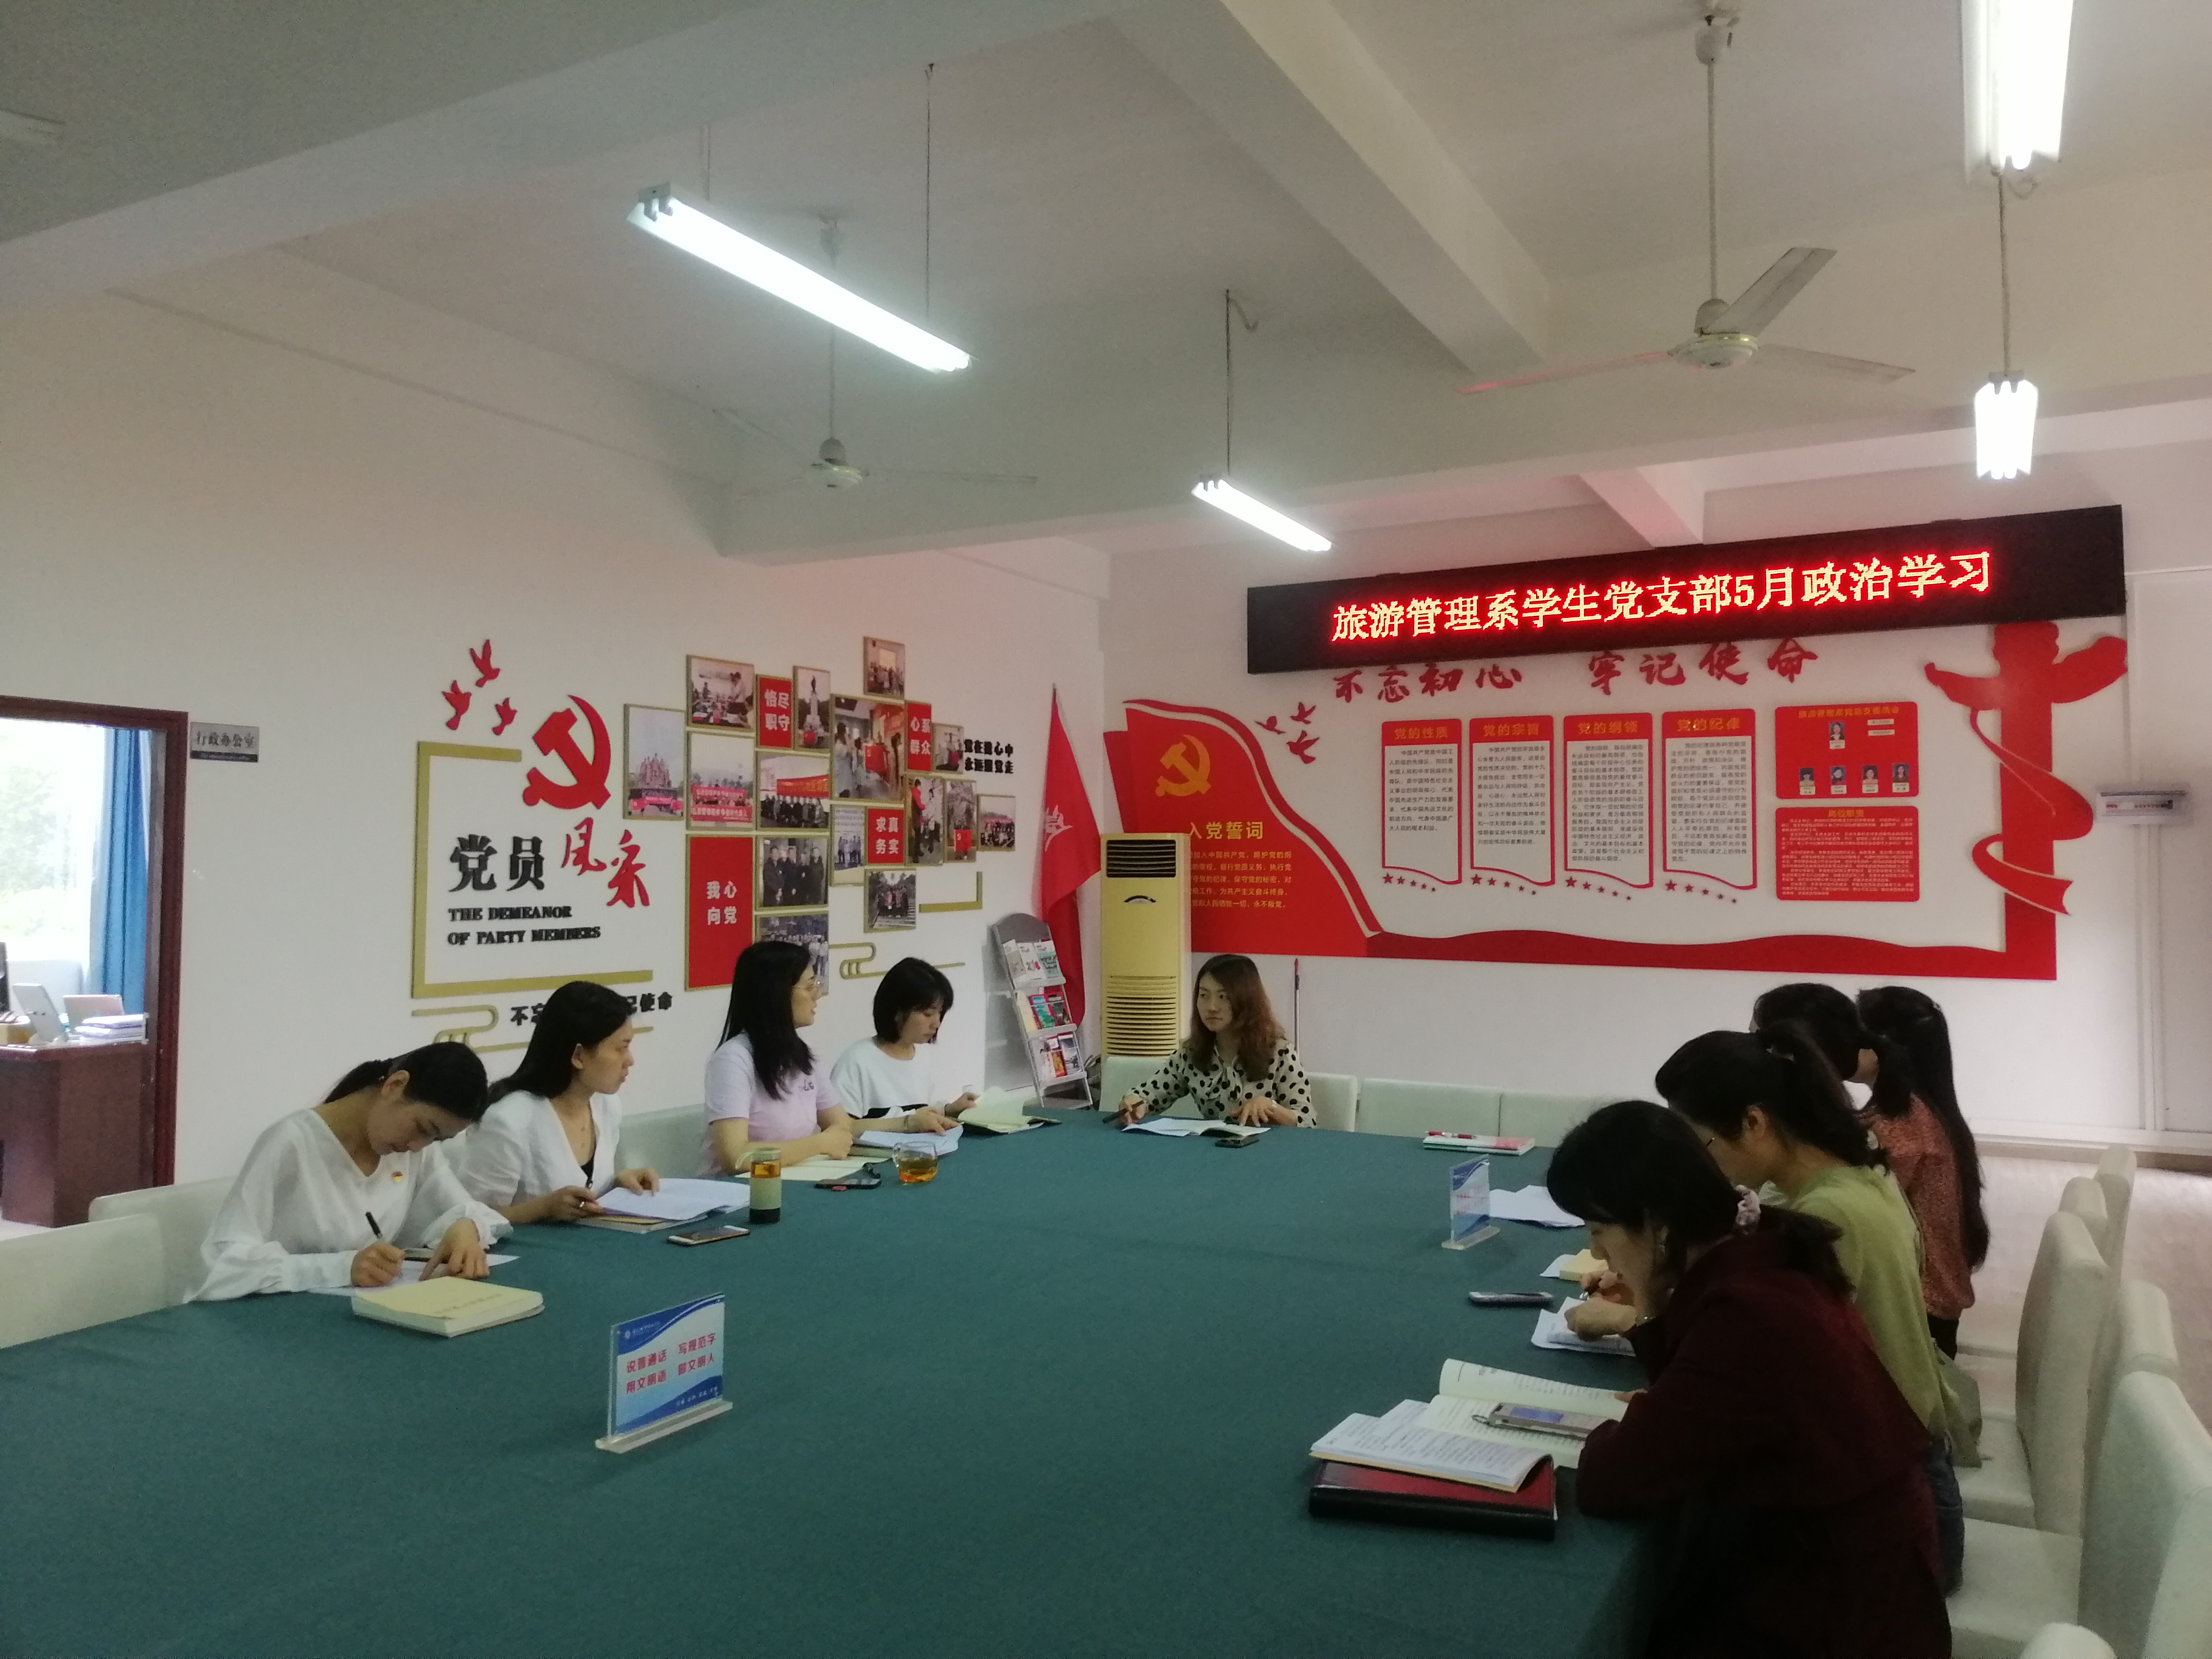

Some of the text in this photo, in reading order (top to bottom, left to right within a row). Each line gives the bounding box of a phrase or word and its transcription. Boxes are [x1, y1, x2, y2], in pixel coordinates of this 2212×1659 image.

[1332, 551, 1990, 642] 旅游管理系学生党支部5月政治学习
[1334, 638, 1818, 703] 不忘初心 牢记使命
[765, 712, 790, 732] 职守
[1483, 722, 1539, 737] 党的宗旨
[1578, 721, 1638, 735] 党的纲领
[1677, 717, 1741, 732] 党的纪律
[1394, 726, 1448, 740] 党的性质
[876, 817, 899, 832] 求真
[1190, 821, 1263, 840] 入党誓词
[876, 838, 899, 854] 务实
[449, 817, 650, 908] 党员 风采
[707, 880, 737, 899] 我心
[448, 906, 572, 921] THE DEMEANOR
[708, 906, 737, 926] 向党
[447, 926, 601, 945] OF PARTY MEMBERS
[626, 1333, 716, 1373] 说普通话 写规范字
